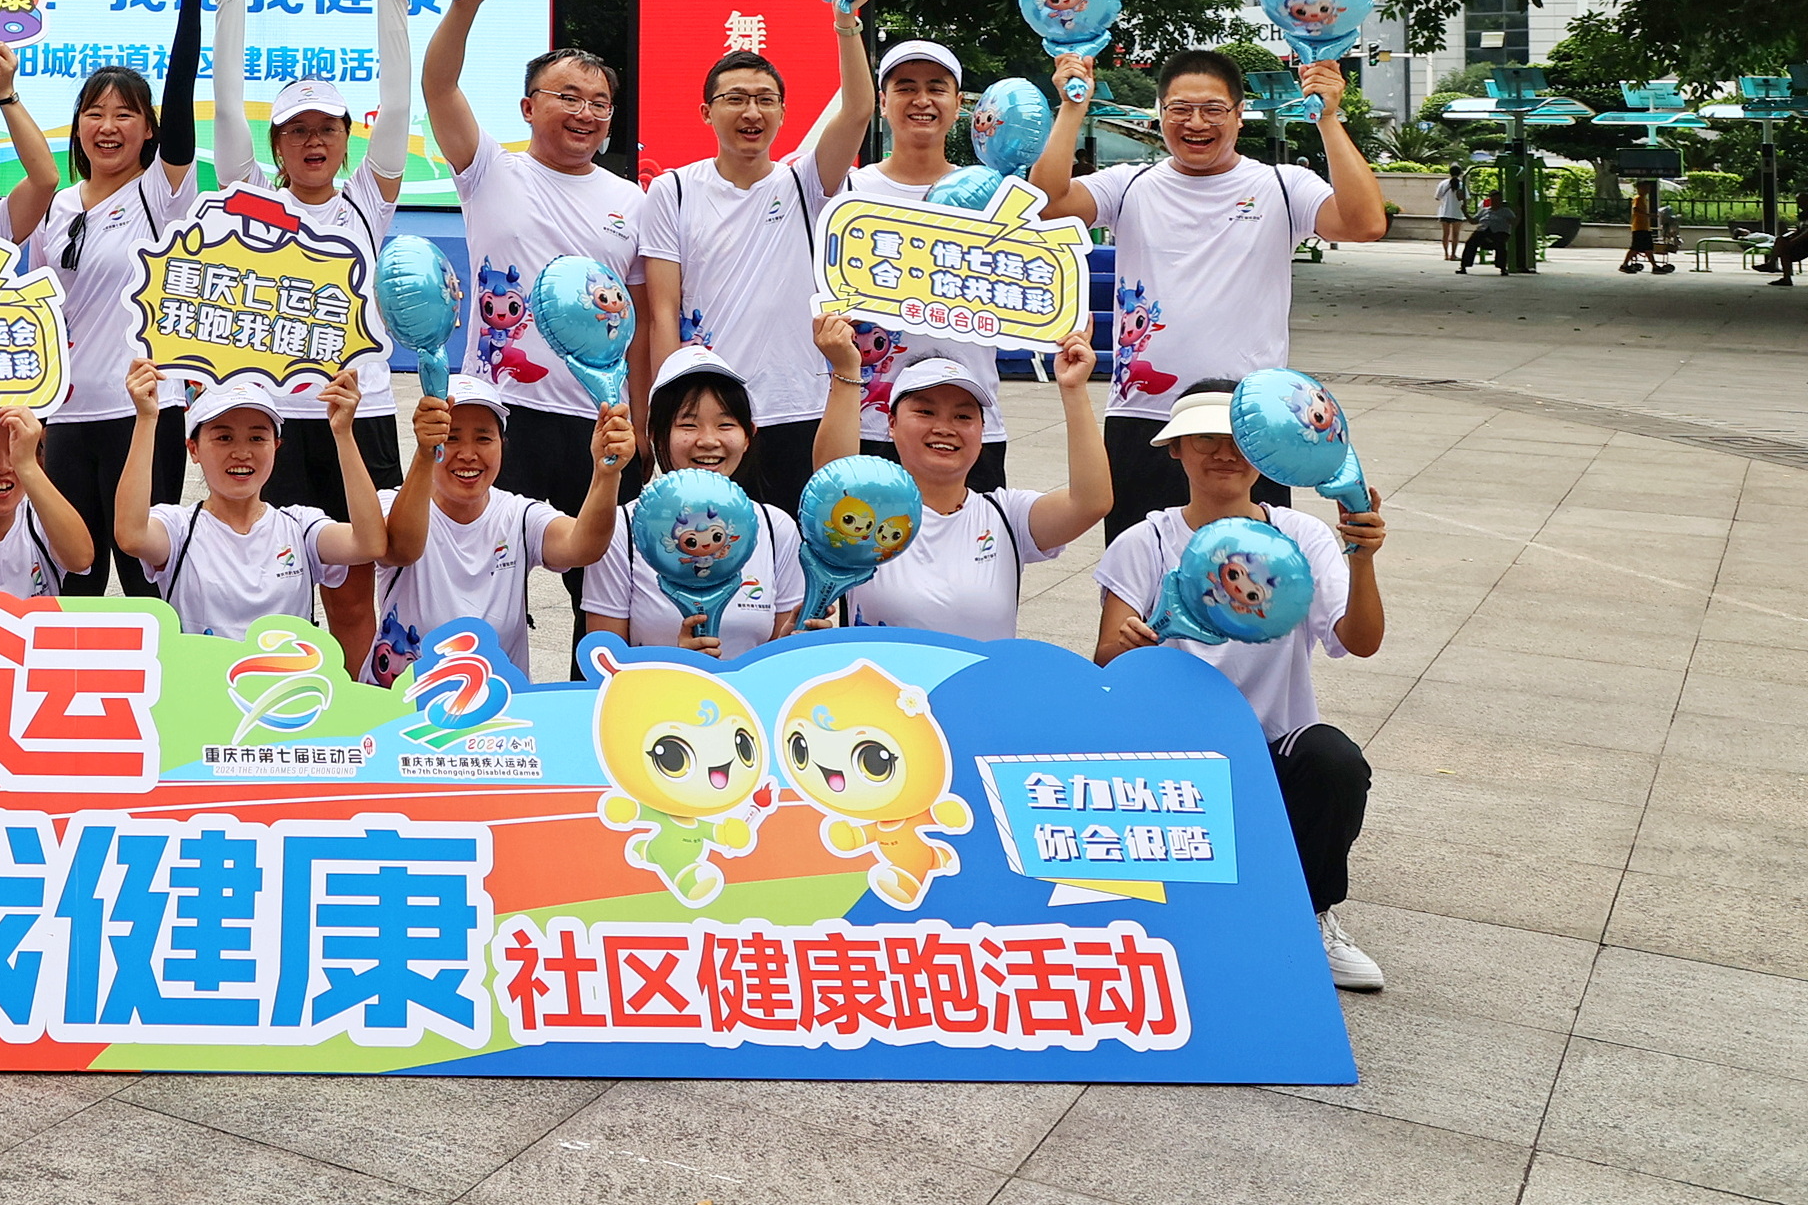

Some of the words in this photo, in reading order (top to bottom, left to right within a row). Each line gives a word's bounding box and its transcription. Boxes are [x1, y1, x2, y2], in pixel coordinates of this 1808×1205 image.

[164, 257, 354, 325] 重庆七运会
[160, 298, 346, 365] 我跑我健康
[905, 302, 996, 333] 幸福合阳
[204, 747, 363, 765] 重庆市第七届运动会
[467, 738, 504, 750] 2024
[510, 738, 535, 751] 合川
[215, 766, 235, 774] 2024
[238, 766, 253, 774] THE
[255, 766, 268, 774] 7th
[270, 766, 296, 774] GAMES
[298, 766, 309, 774] OF
[311, 766, 354, 775] CHONGQING
[401, 756, 539, 769] 重庆市第七届残疾人运动会
[432, 768, 475, 777] Chongqing
[513, 769, 540, 777] Games
[1026, 770, 1206, 814] 全力以赴
[1034, 821, 1215, 864] 你会很酷
[503, 928, 1179, 1039] 社区健康跑活动
